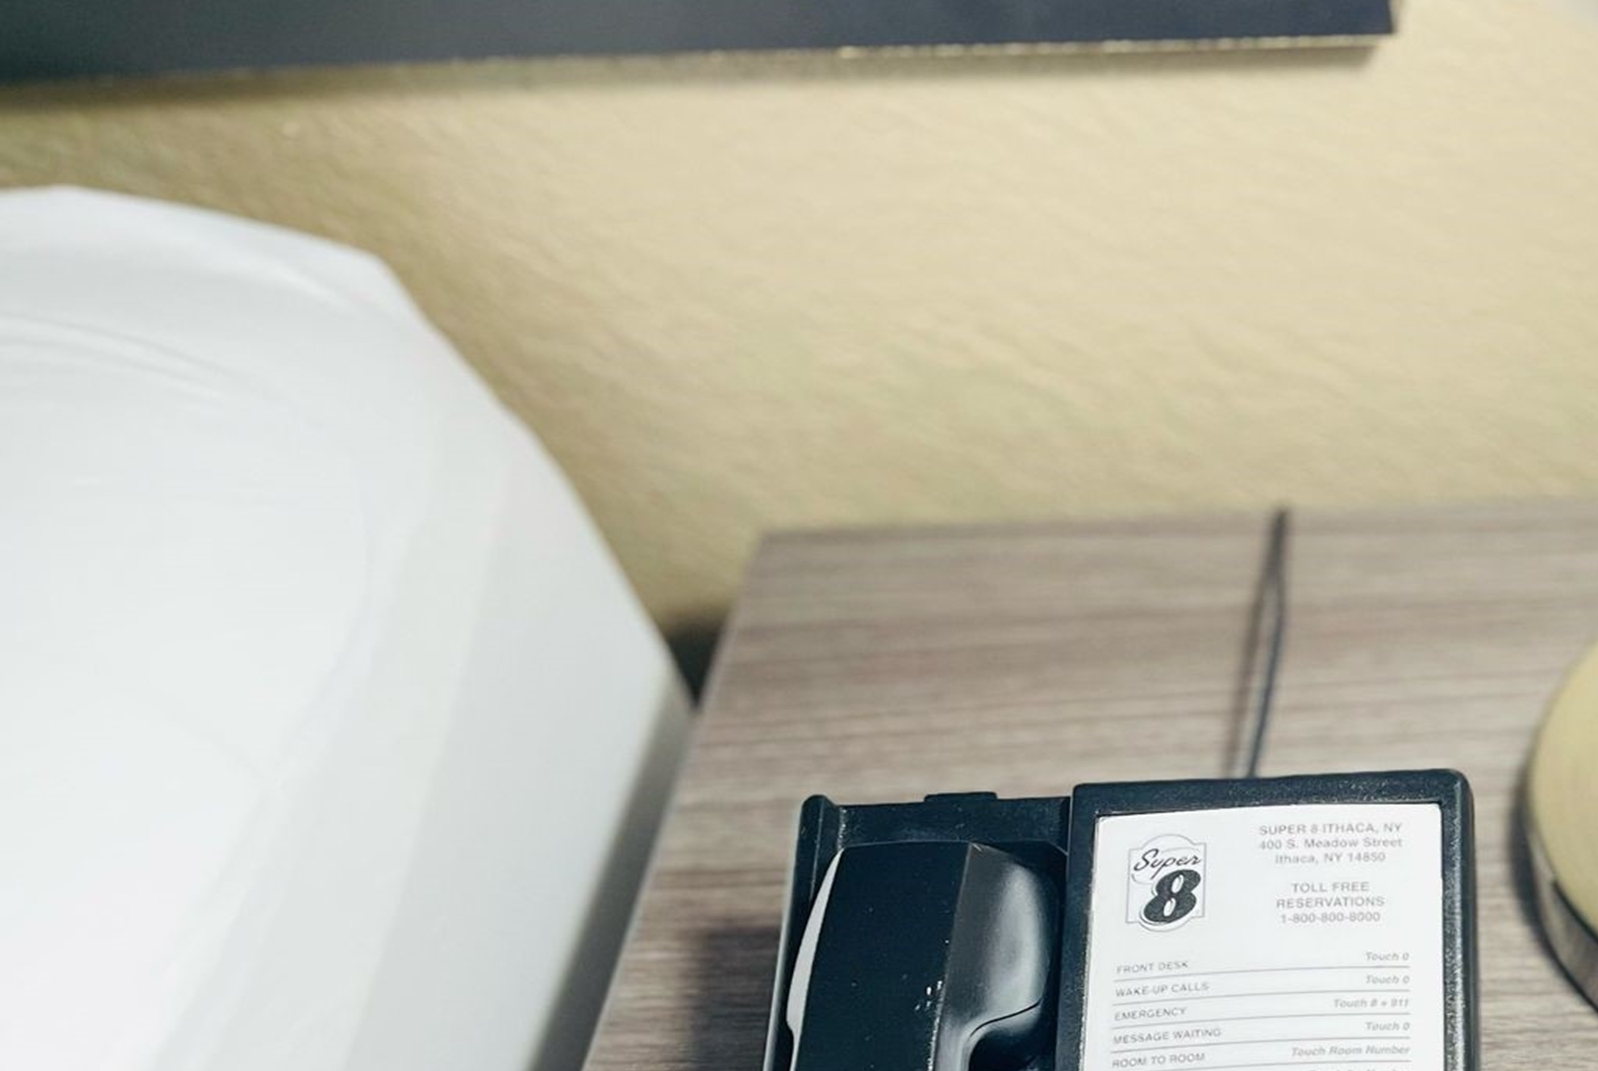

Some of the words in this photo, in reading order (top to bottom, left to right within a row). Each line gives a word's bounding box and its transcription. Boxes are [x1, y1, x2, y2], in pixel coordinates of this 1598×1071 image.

[1259, 823, 1307, 836] SUPER
[1310, 823, 1319, 834] 8
[1322, 822, 1379, 835] ITHACA,
[1383, 822, 1403, 833] NY
[1259, 839, 1283, 850] 400
[1286, 838, 1299, 849] S.
[1303, 837, 1359, 848] Meadow
[1362, 836, 1403, 848] Street
[1133, 847, 1203, 880] Super
[1275, 853, 1319, 866] Ithaca,
[1324, 852, 1343, 863] NY
[1348, 851, 1387, 863] 14850
[1139, 868, 1202, 925] 8
[1291, 882, 1328, 894] TOLL
[1331, 881, 1370, 893] FREE
[1275, 895, 1386, 910] RESERVATIONS
[1280, 911, 1382, 924] 1-800-800-8000
[1116, 962, 1155, 974] FRONT
[1158, 960, 1189, 972] DESK
[1365, 951, 1399, 962] Touch
[1170, 981, 1210, 993] CALLS
[1365, 974, 1399, 985] Touch
[1114, 1006, 1188, 1021] EMERGENCY
[1333, 998, 1368, 1008] Touch
[1113, 1031, 1170, 1045] MESSAGE
[1172, 1028, 1222, 1040] WAITING
[1366, 1021, 1400, 1031] Touch
[1112, 1057, 1147, 1068] ROOM
[1151, 1055, 1167, 1065] TO
[1169, 1053, 1206, 1064] ROOM
[1291, 1046, 1327, 1057] Touch
[1329, 1045, 1363, 1056] Room
[1365, 1044, 1411, 1055] Number
